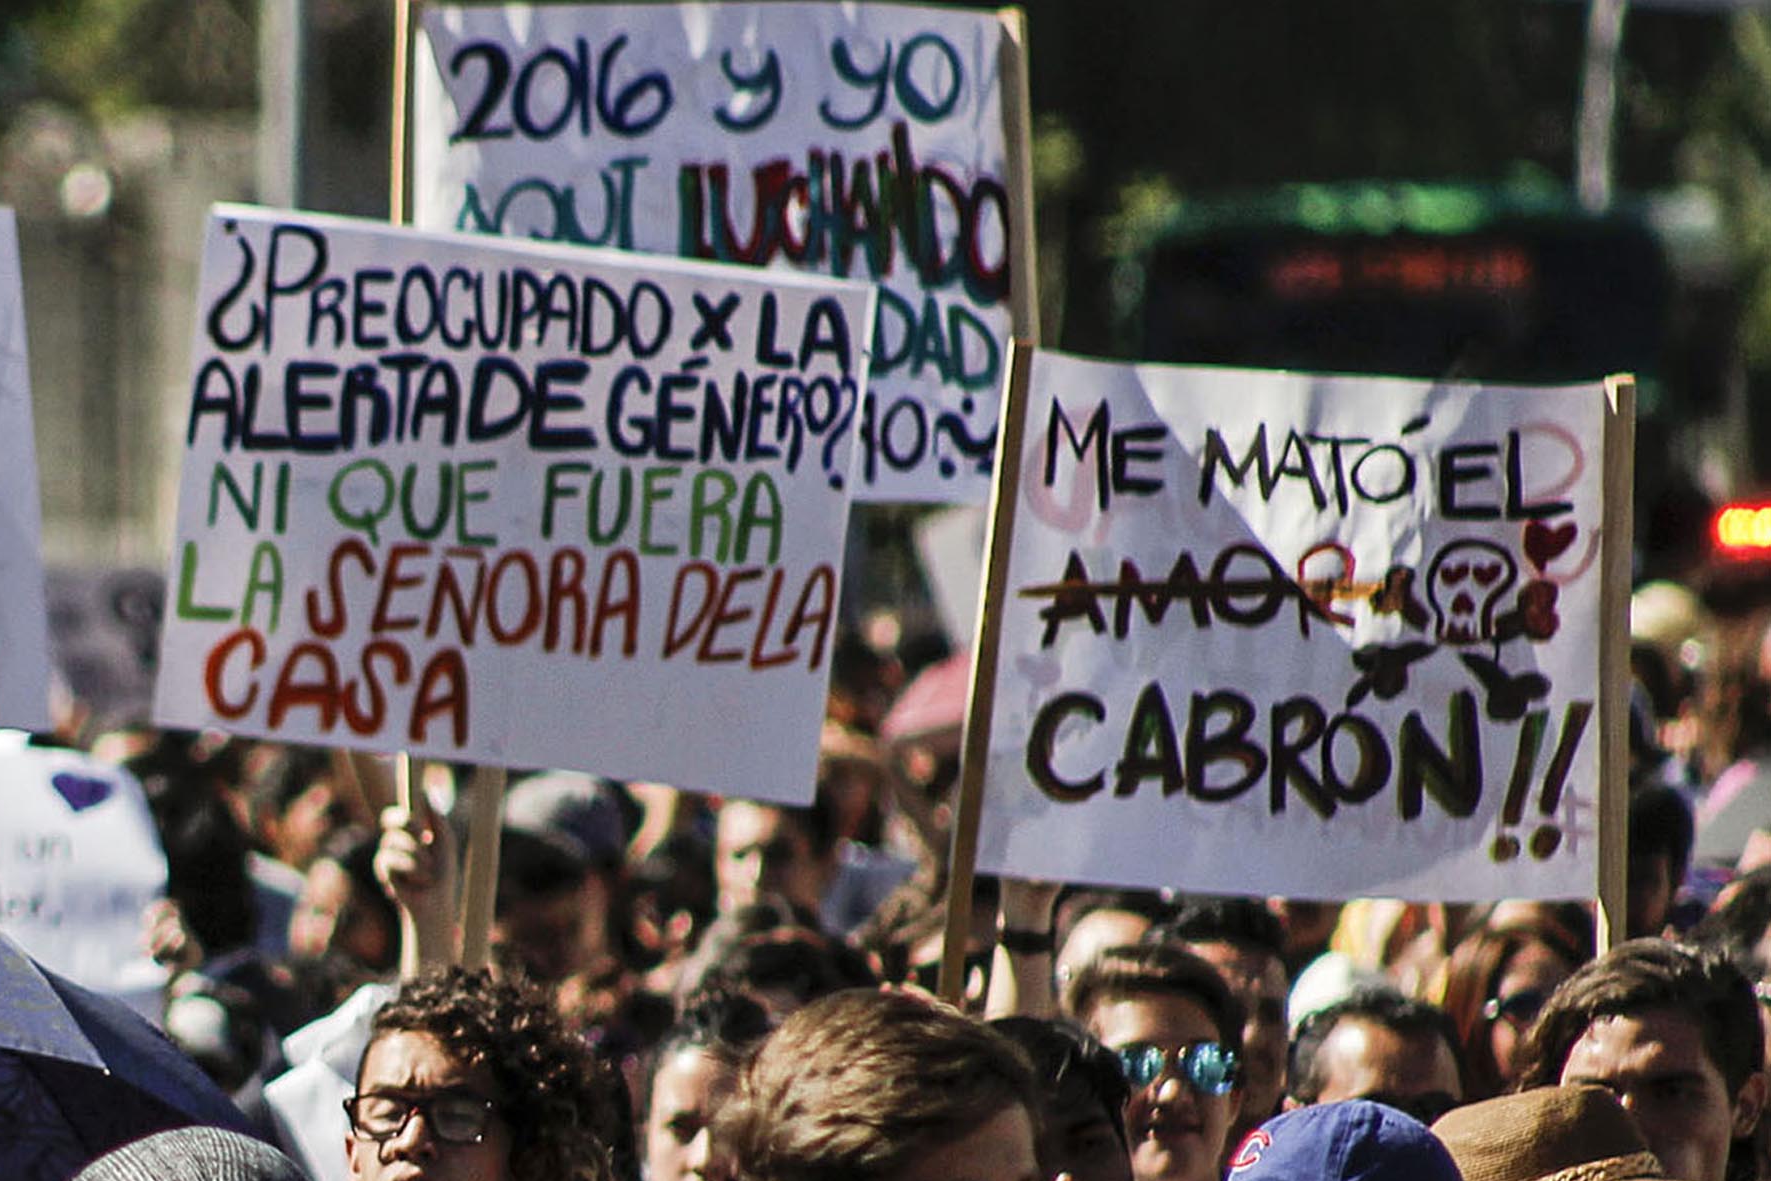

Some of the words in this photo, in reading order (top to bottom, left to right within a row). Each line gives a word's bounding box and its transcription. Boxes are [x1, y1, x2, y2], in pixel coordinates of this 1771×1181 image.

[449, 34, 674, 145] 2016
[207, 218, 673, 358] ¿PREOCUPADO
[756, 291, 851, 377] LA
[606, 356, 859, 490] GÉNERO?
[1045, 395, 1167, 510] ME
[1198, 416, 1429, 516] MATÓ
[1439, 429, 1573, 519] EL
[207, 461, 291, 535] NI
[327, 458, 498, 547] QUE
[541, 462, 783, 563] FUERA
[177, 541, 284, 634] LA
[306, 538, 641, 661] SEÑORA
[204, 627, 469, 747] CASA
